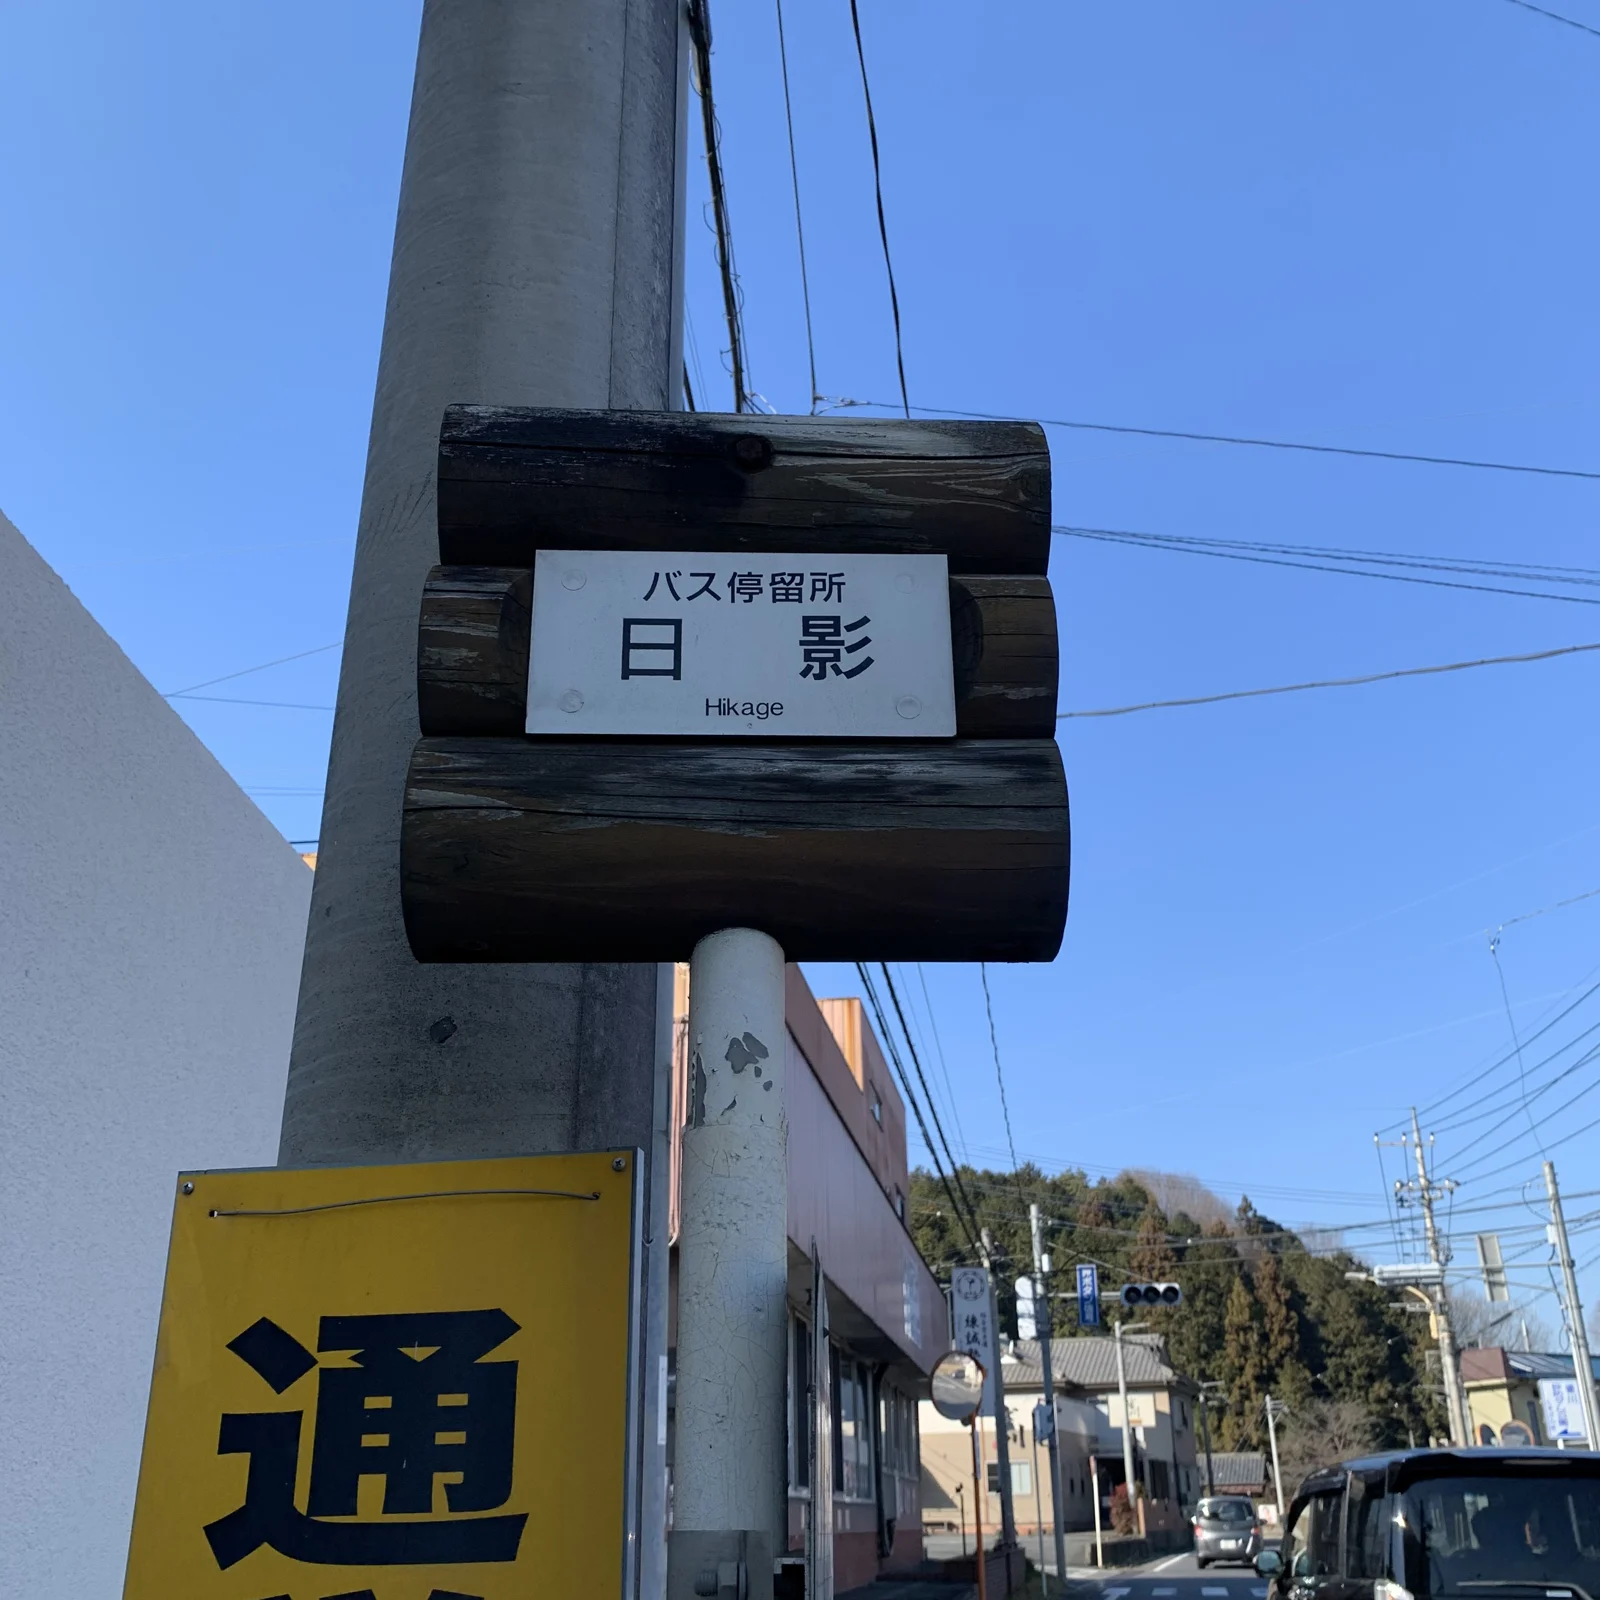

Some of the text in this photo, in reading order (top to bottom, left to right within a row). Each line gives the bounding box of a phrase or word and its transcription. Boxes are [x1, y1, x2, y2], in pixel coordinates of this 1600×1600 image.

[642, 570, 846, 603] バス停留所
[704, 697, 784, 719] Hikage
[203, 1308, 529, 1600] 通
